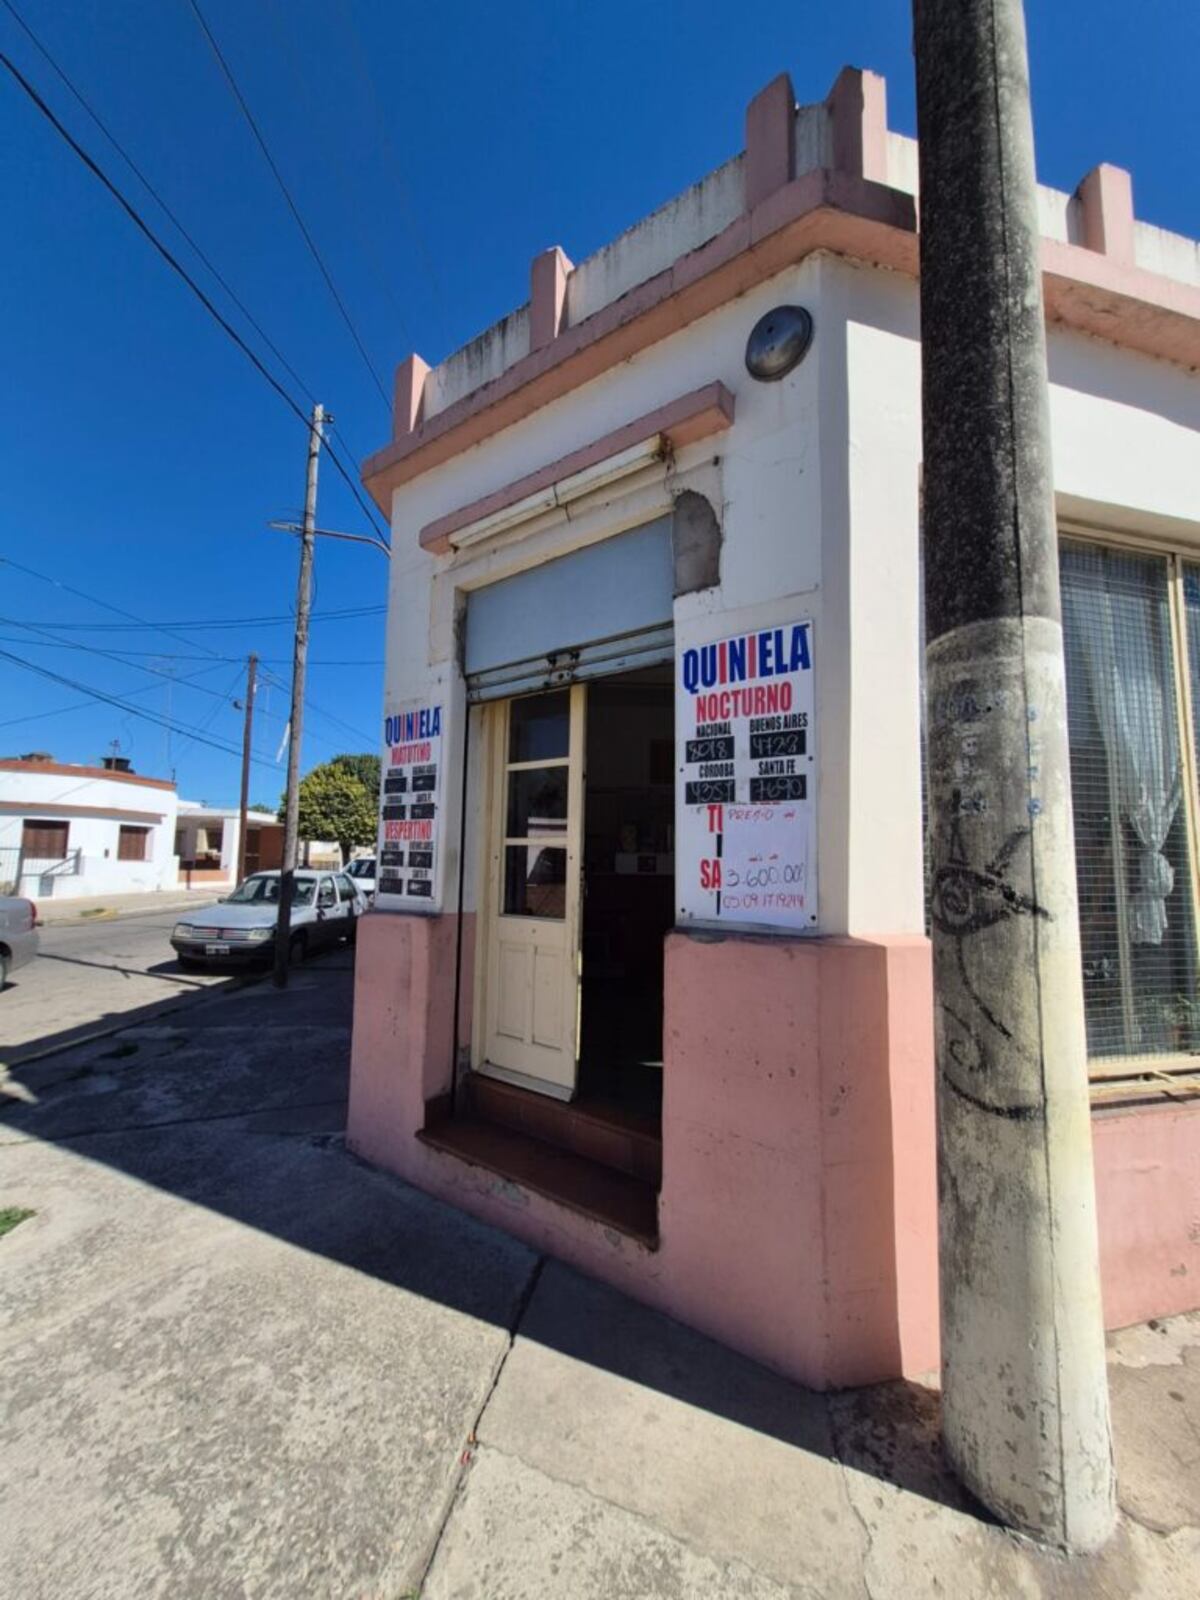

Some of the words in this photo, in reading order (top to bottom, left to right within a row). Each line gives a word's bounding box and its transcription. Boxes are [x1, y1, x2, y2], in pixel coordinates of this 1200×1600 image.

[683, 623, 811, 694] QUINIELA
[696, 681, 793, 724] NOCTURNO
[749, 717, 782, 733] BUENOS
[783, 712, 809, 729] AIRES
[385, 706, 442, 747] QUINIELA
[758, 760, 784, 776] SANTA
[786, 759, 796, 774] FE
